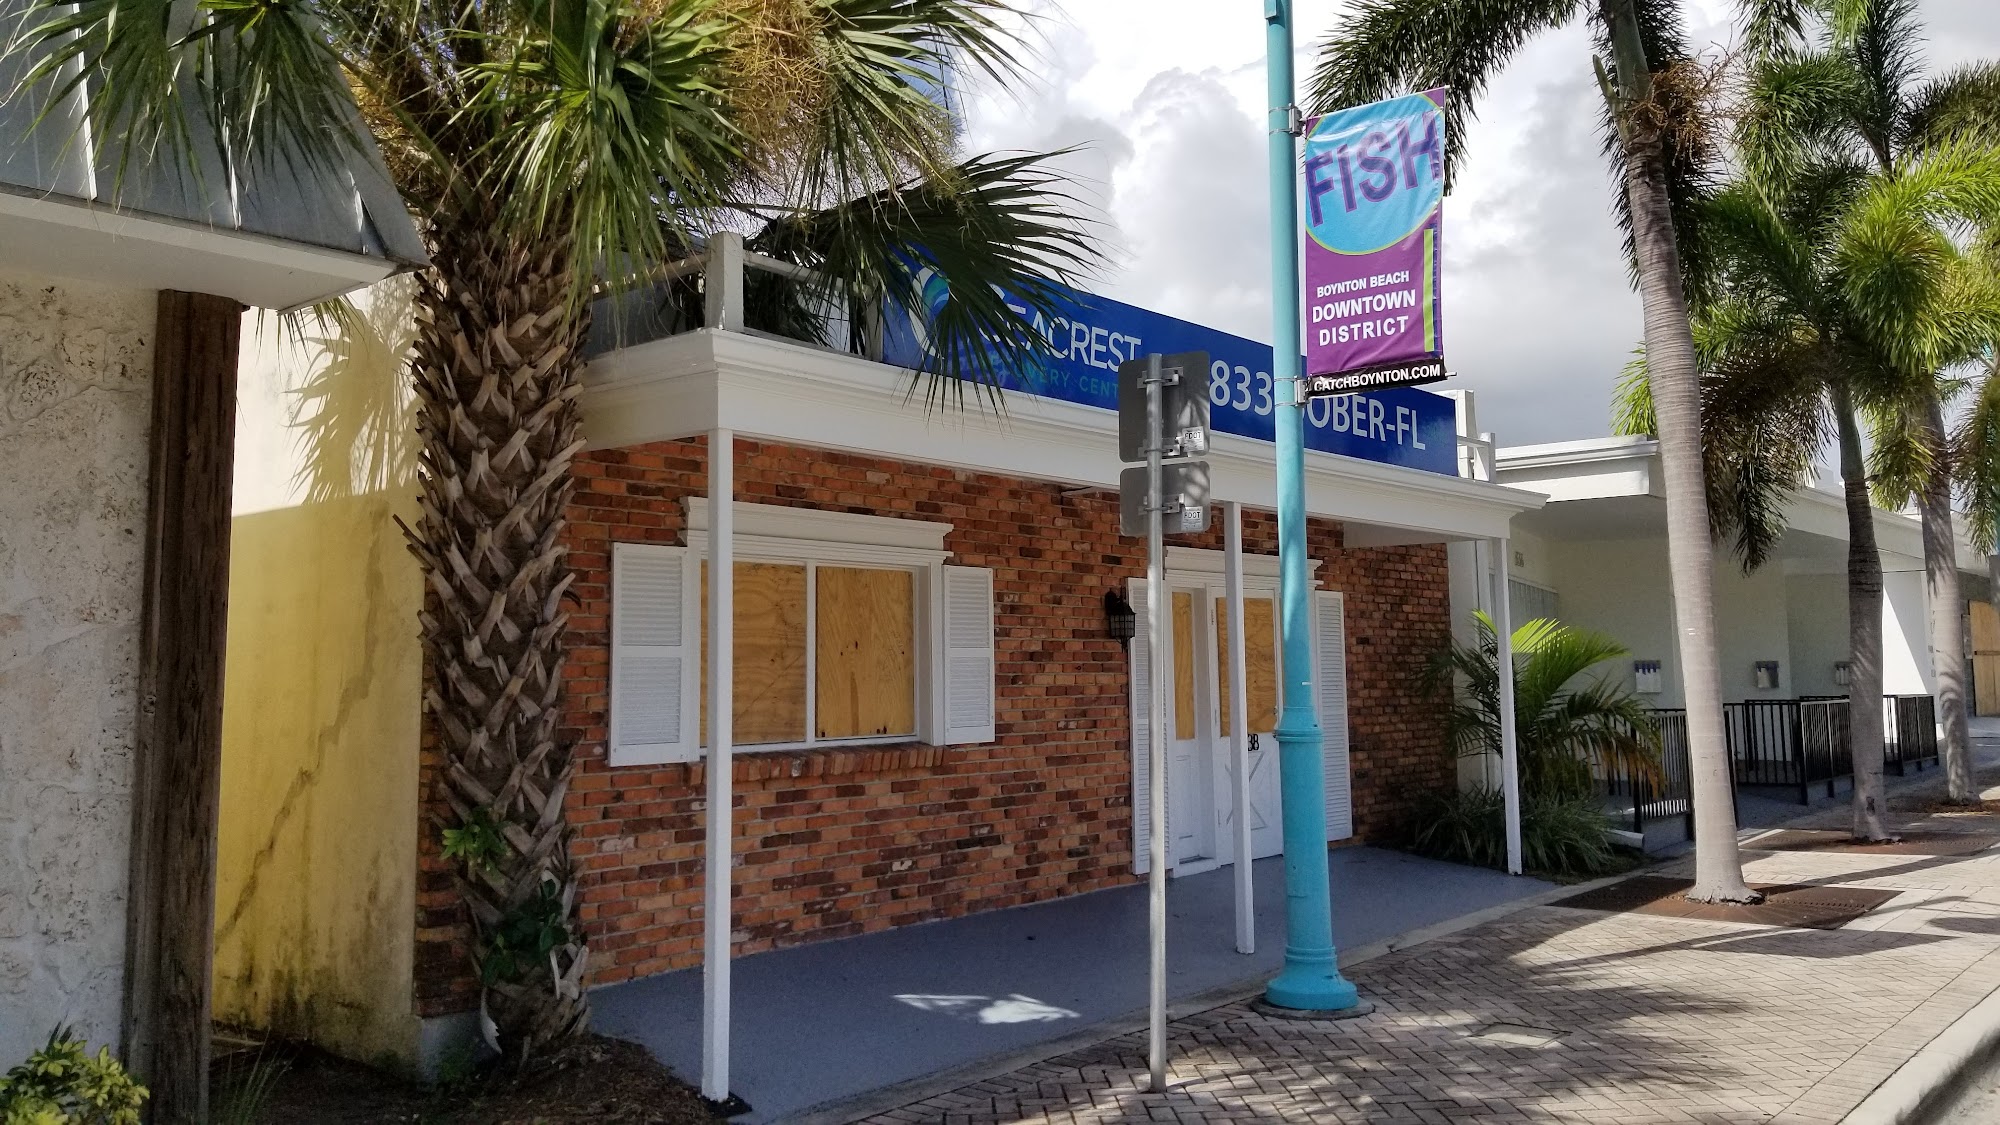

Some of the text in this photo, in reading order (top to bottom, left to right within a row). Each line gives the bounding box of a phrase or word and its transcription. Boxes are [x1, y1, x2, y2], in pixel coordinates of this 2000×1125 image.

[1305, 110, 1442, 227] FISH
[1316, 271, 1410, 298] BOYNTON BEACH
[1312, 289, 1416, 323] DOWNTOWN
[1319, 316, 1409, 346] DISTRICT
[1313, 364, 1441, 391] CATCHBOYNTON.COM
[1302, 395, 1427, 452] OBER-FL
